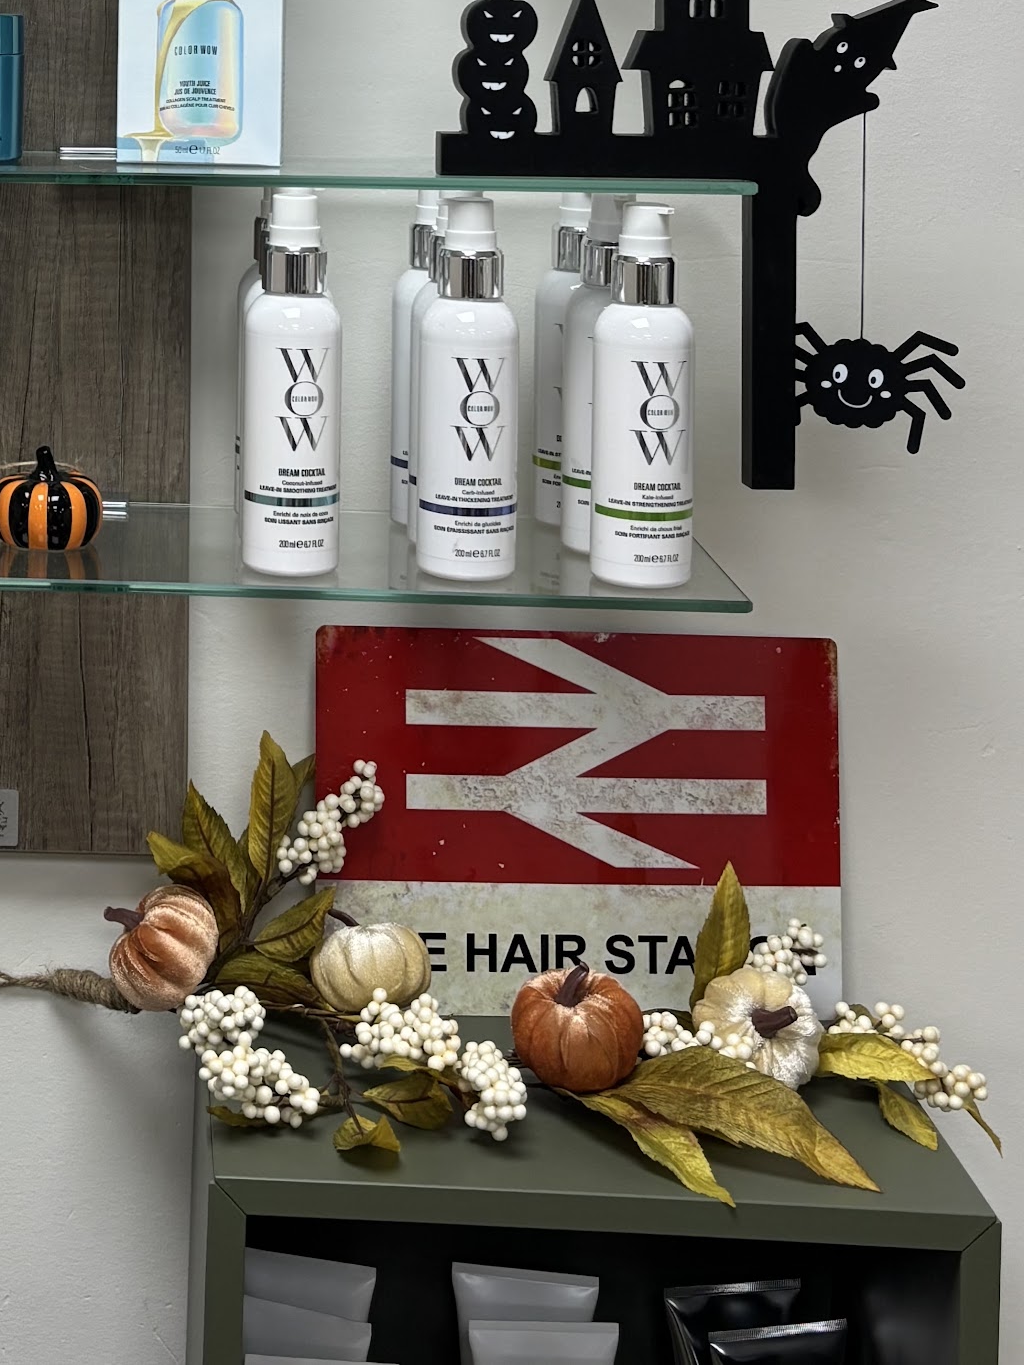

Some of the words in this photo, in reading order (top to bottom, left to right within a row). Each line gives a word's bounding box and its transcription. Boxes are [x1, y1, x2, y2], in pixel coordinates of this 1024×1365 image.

[174, 45, 198, 56] COLOR
[200, 45, 218, 56] WOW
[274, 347, 330, 452] WOW
[450, 357, 507, 462] WOW
[629, 360, 687, 466] WOW
[278, 468, 300, 476] DREAM
[301, 468, 325, 476] COCKTAIL
[478, 478, 502, 486] COCKTAIL
[657, 482, 682, 491] COCKTAIL
[466, 933, 586, 974] HAIR
